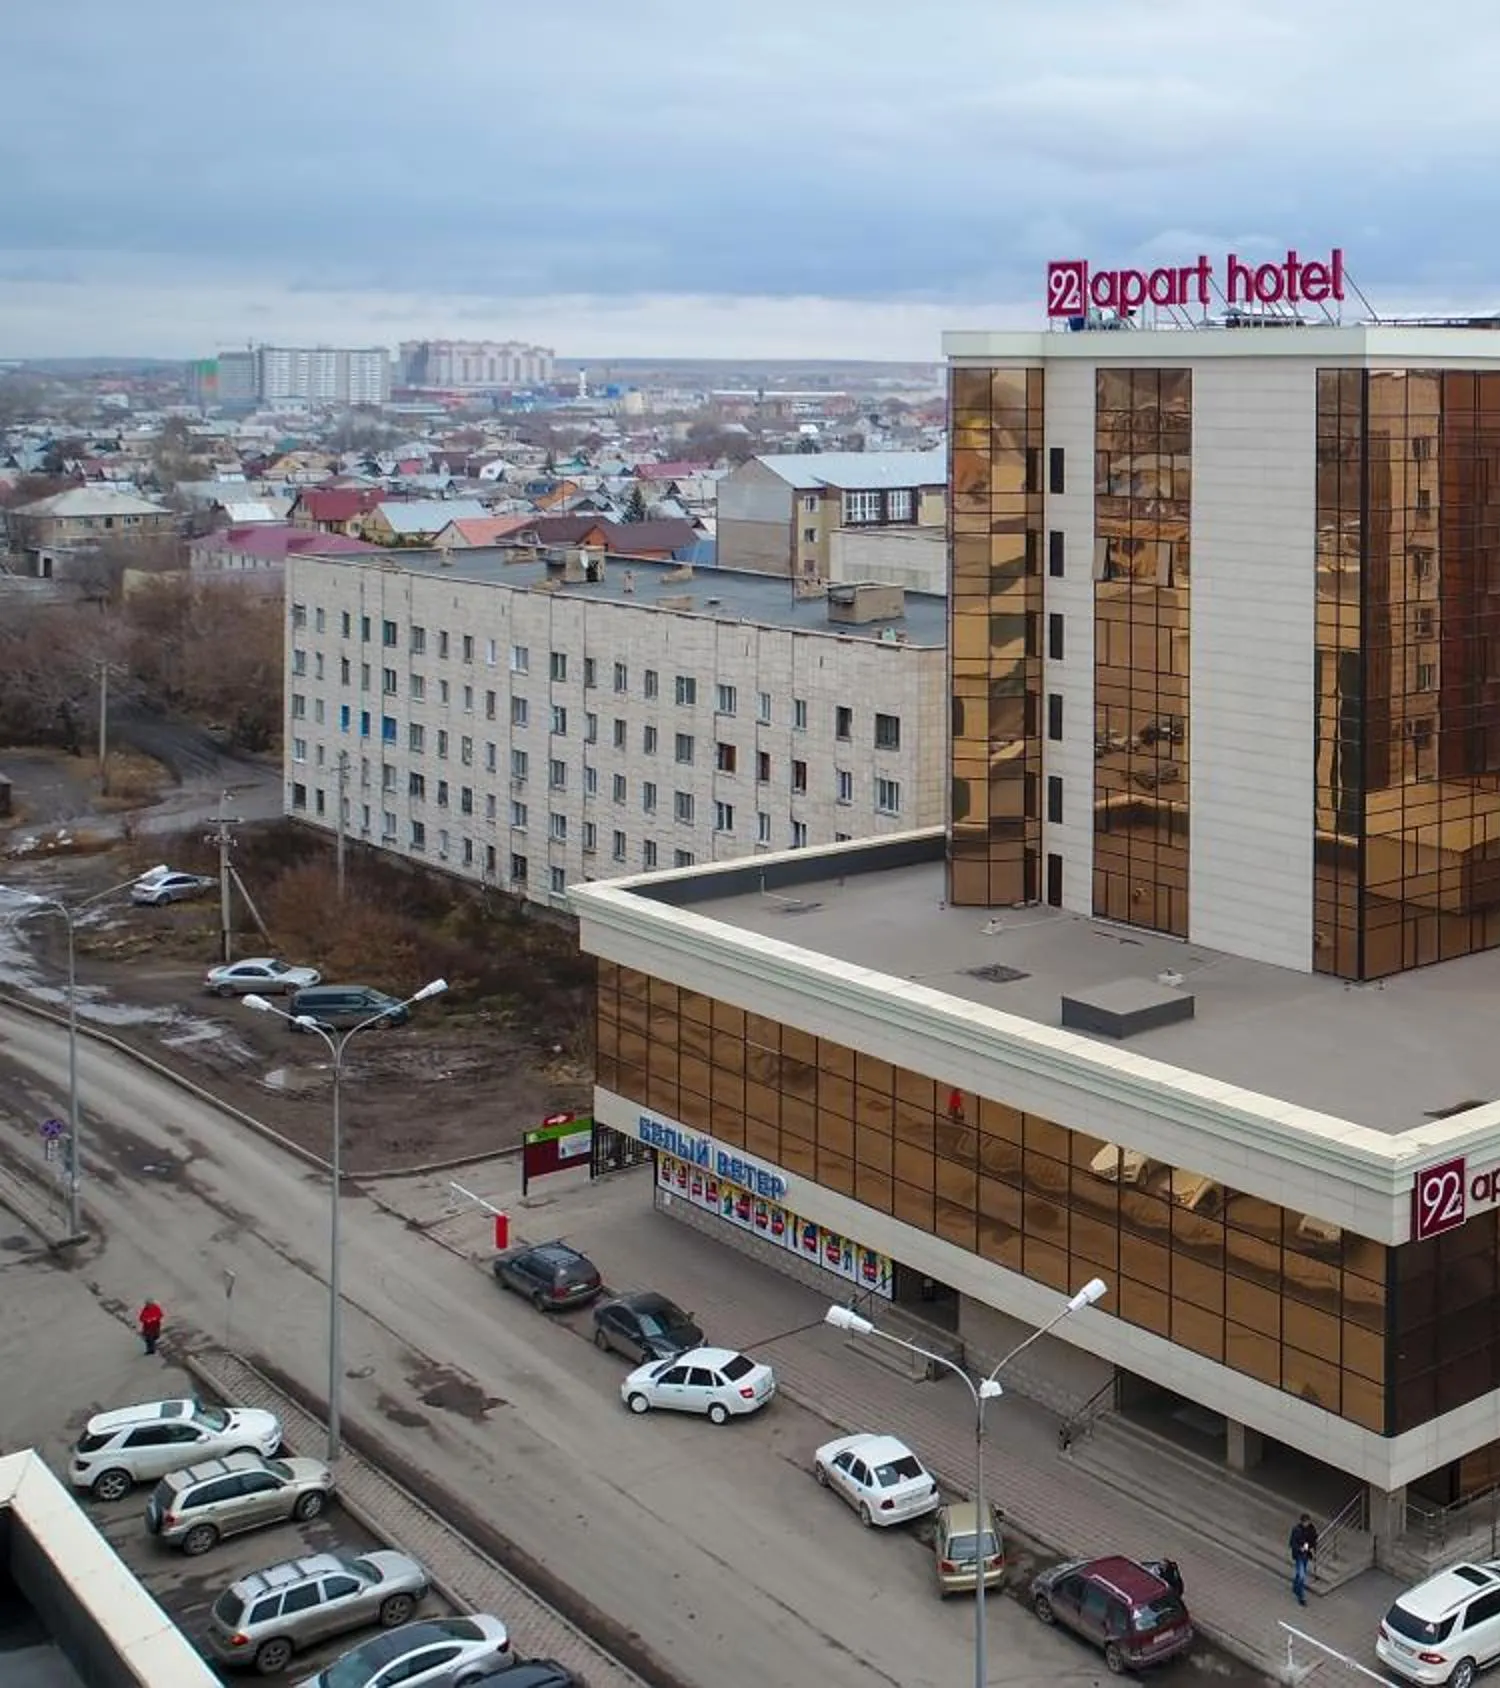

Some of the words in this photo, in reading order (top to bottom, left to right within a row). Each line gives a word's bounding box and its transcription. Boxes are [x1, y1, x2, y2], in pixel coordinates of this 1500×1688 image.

[1050, 269, 1081, 309] 92
[1090, 255, 1212, 318] apart
[1227, 248, 1345, 304] hotel
[639, 1115, 714, 1168] БЕЛЫЙ
[716, 1150, 788, 1200] ВЕТЕР
[1422, 1171, 1463, 1229] 92
